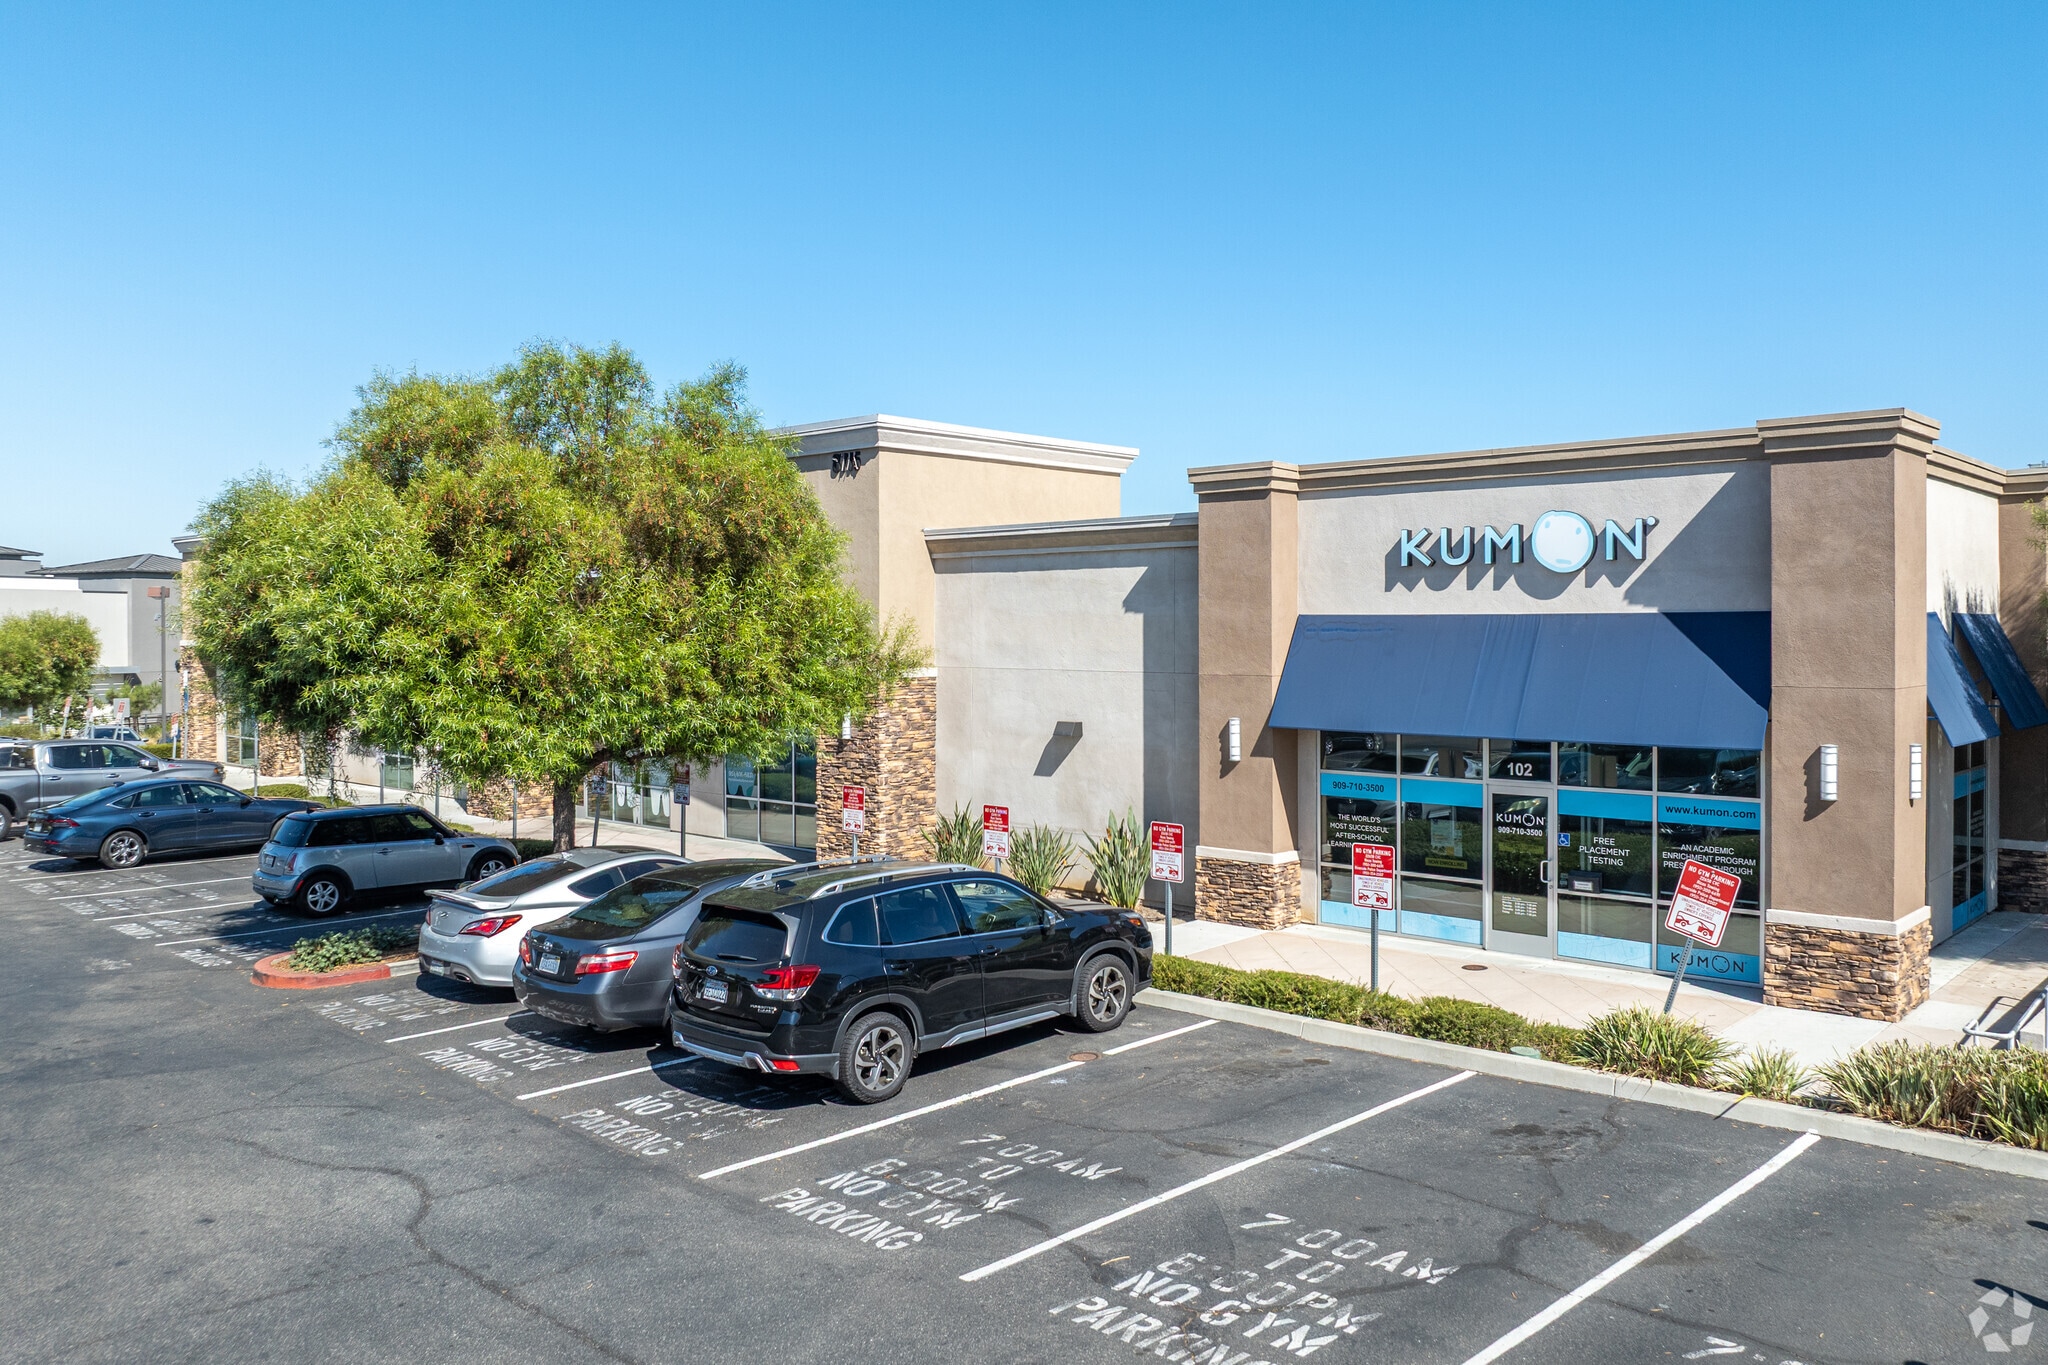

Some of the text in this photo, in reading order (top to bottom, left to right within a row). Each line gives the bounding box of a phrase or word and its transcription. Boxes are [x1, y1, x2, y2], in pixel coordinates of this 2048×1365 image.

[1401, 510, 1650, 573] KUMON
[1507, 762, 1533, 776] 102
[1332, 781, 1385, 793] 909-710-3500
[1337, 813, 1381, 824] THE WORLD'S
[1665, 805, 1756, 819] www.kumon.com
[1496, 812, 1546, 827] KUMON
[1329, 822, 1389, 834] MOST SUCCESSFUL
[1497, 826, 1543, 837] 909-710-3500
[1335, 831, 1384, 842] AFTER-SCHOOL
[1593, 836, 1616, 846] FREE
[1327, 840, 1353, 848] LEARNIN
[1578, 845, 1631, 857] PLACEMENT
[1680, 843, 1735, 855] AN ACADEMIC
[1587, 855, 1624, 867] TESTING
[1662, 851, 1756, 866] ENRICHMENT PROGRAM
[1687, 864, 1697, 873] NO
[1697, 868, 1710, 878] GYM
[1710, 873, 1735, 887] PARKING
[467, 1037, 566, 1071] NO GYM
[419, 1046, 514, 1083] PARKING
[615, 1095, 674, 1116] NO
[560, 1107, 685, 1157] PARKING
[816, 1170, 983, 1230] NO GYM
[759, 1187, 925, 1251] PARKING
[1264, 1247, 1346, 1284] TO
[1110, 1270, 1340, 1358] NO GYM
